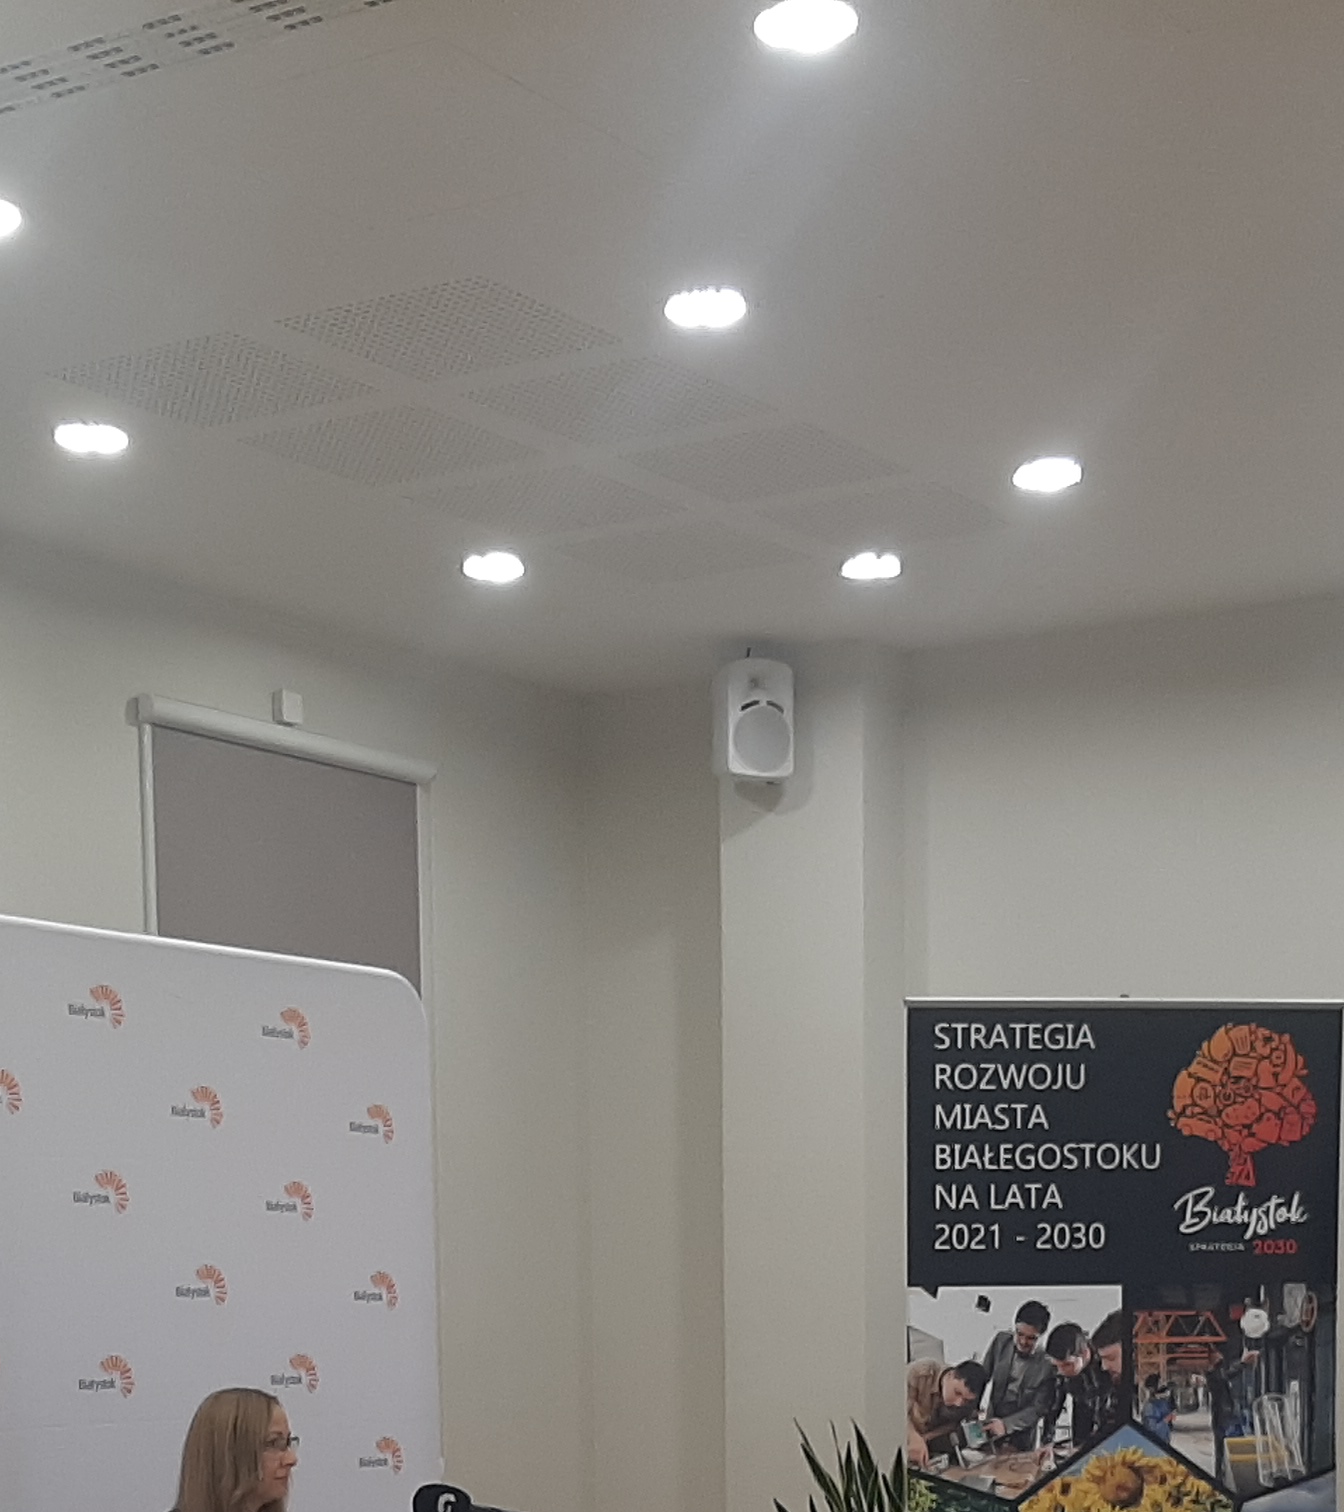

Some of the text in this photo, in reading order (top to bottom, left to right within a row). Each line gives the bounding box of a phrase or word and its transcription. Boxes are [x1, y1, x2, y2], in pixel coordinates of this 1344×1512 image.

[934, 1024, 1095, 1050] STRATEGIA
[935, 1063, 1086, 1090] ROZWOJU
[935, 1104, 1049, 1130] MIASTA
[935, 1143, 1161, 1170] BIAŁEGOSTOKU
[935, 1184, 1062, 1210] NA LATA
[1174, 1187, 1309, 1240] Białystok
[934, 1223, 1000, 1249] 2021
[1036, 1223, 1105, 1249] 2030
[1253, 1239, 1297, 1254] 2030
